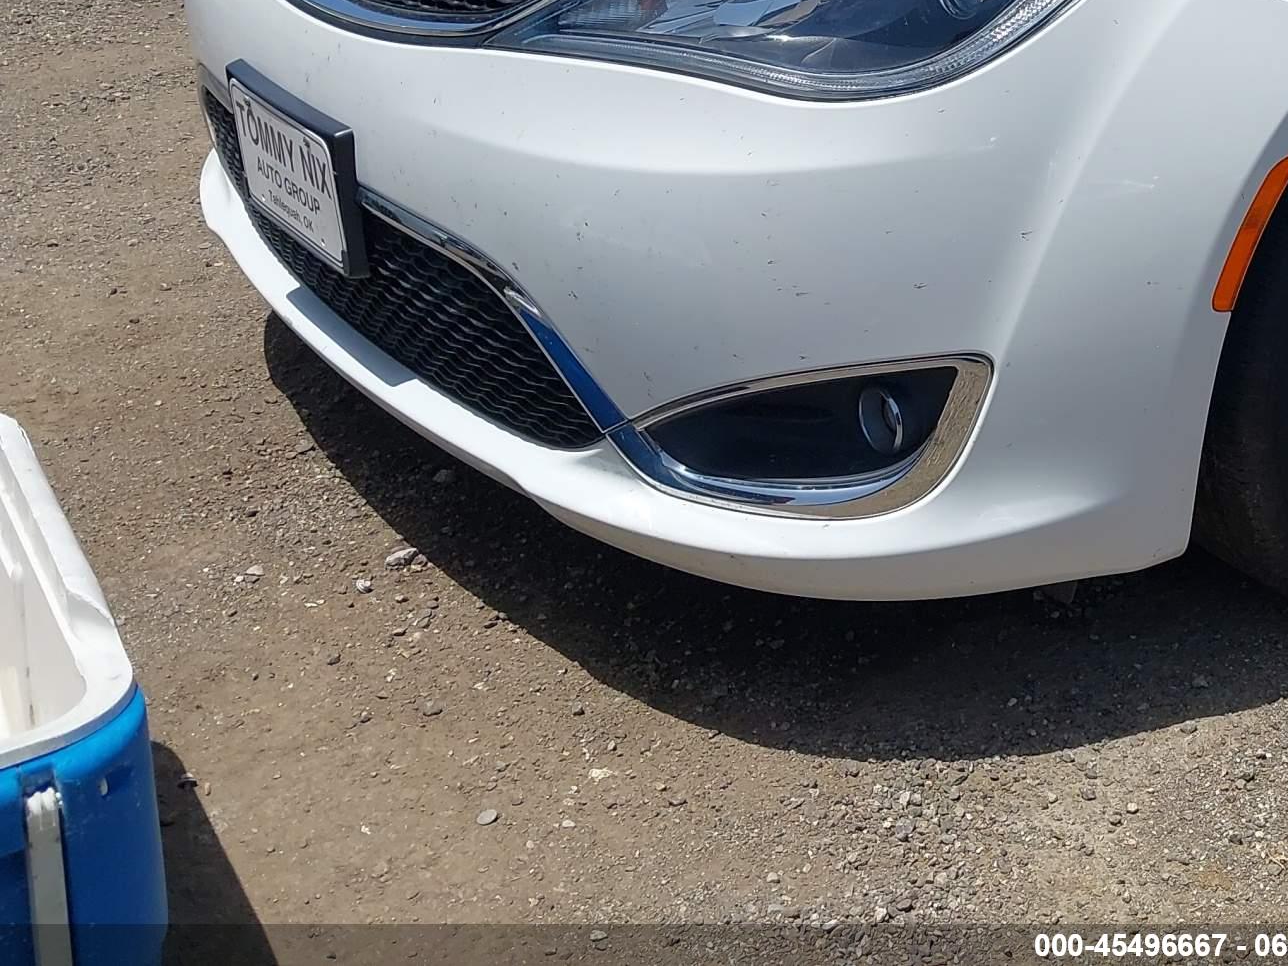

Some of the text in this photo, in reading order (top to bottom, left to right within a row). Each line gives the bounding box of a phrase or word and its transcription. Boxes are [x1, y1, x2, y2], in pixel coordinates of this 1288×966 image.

[236, 100, 333, 201] TOMMY NIX
[257, 155, 321, 215] AUTO GROUP
[303, 215, 314, 233] OK
